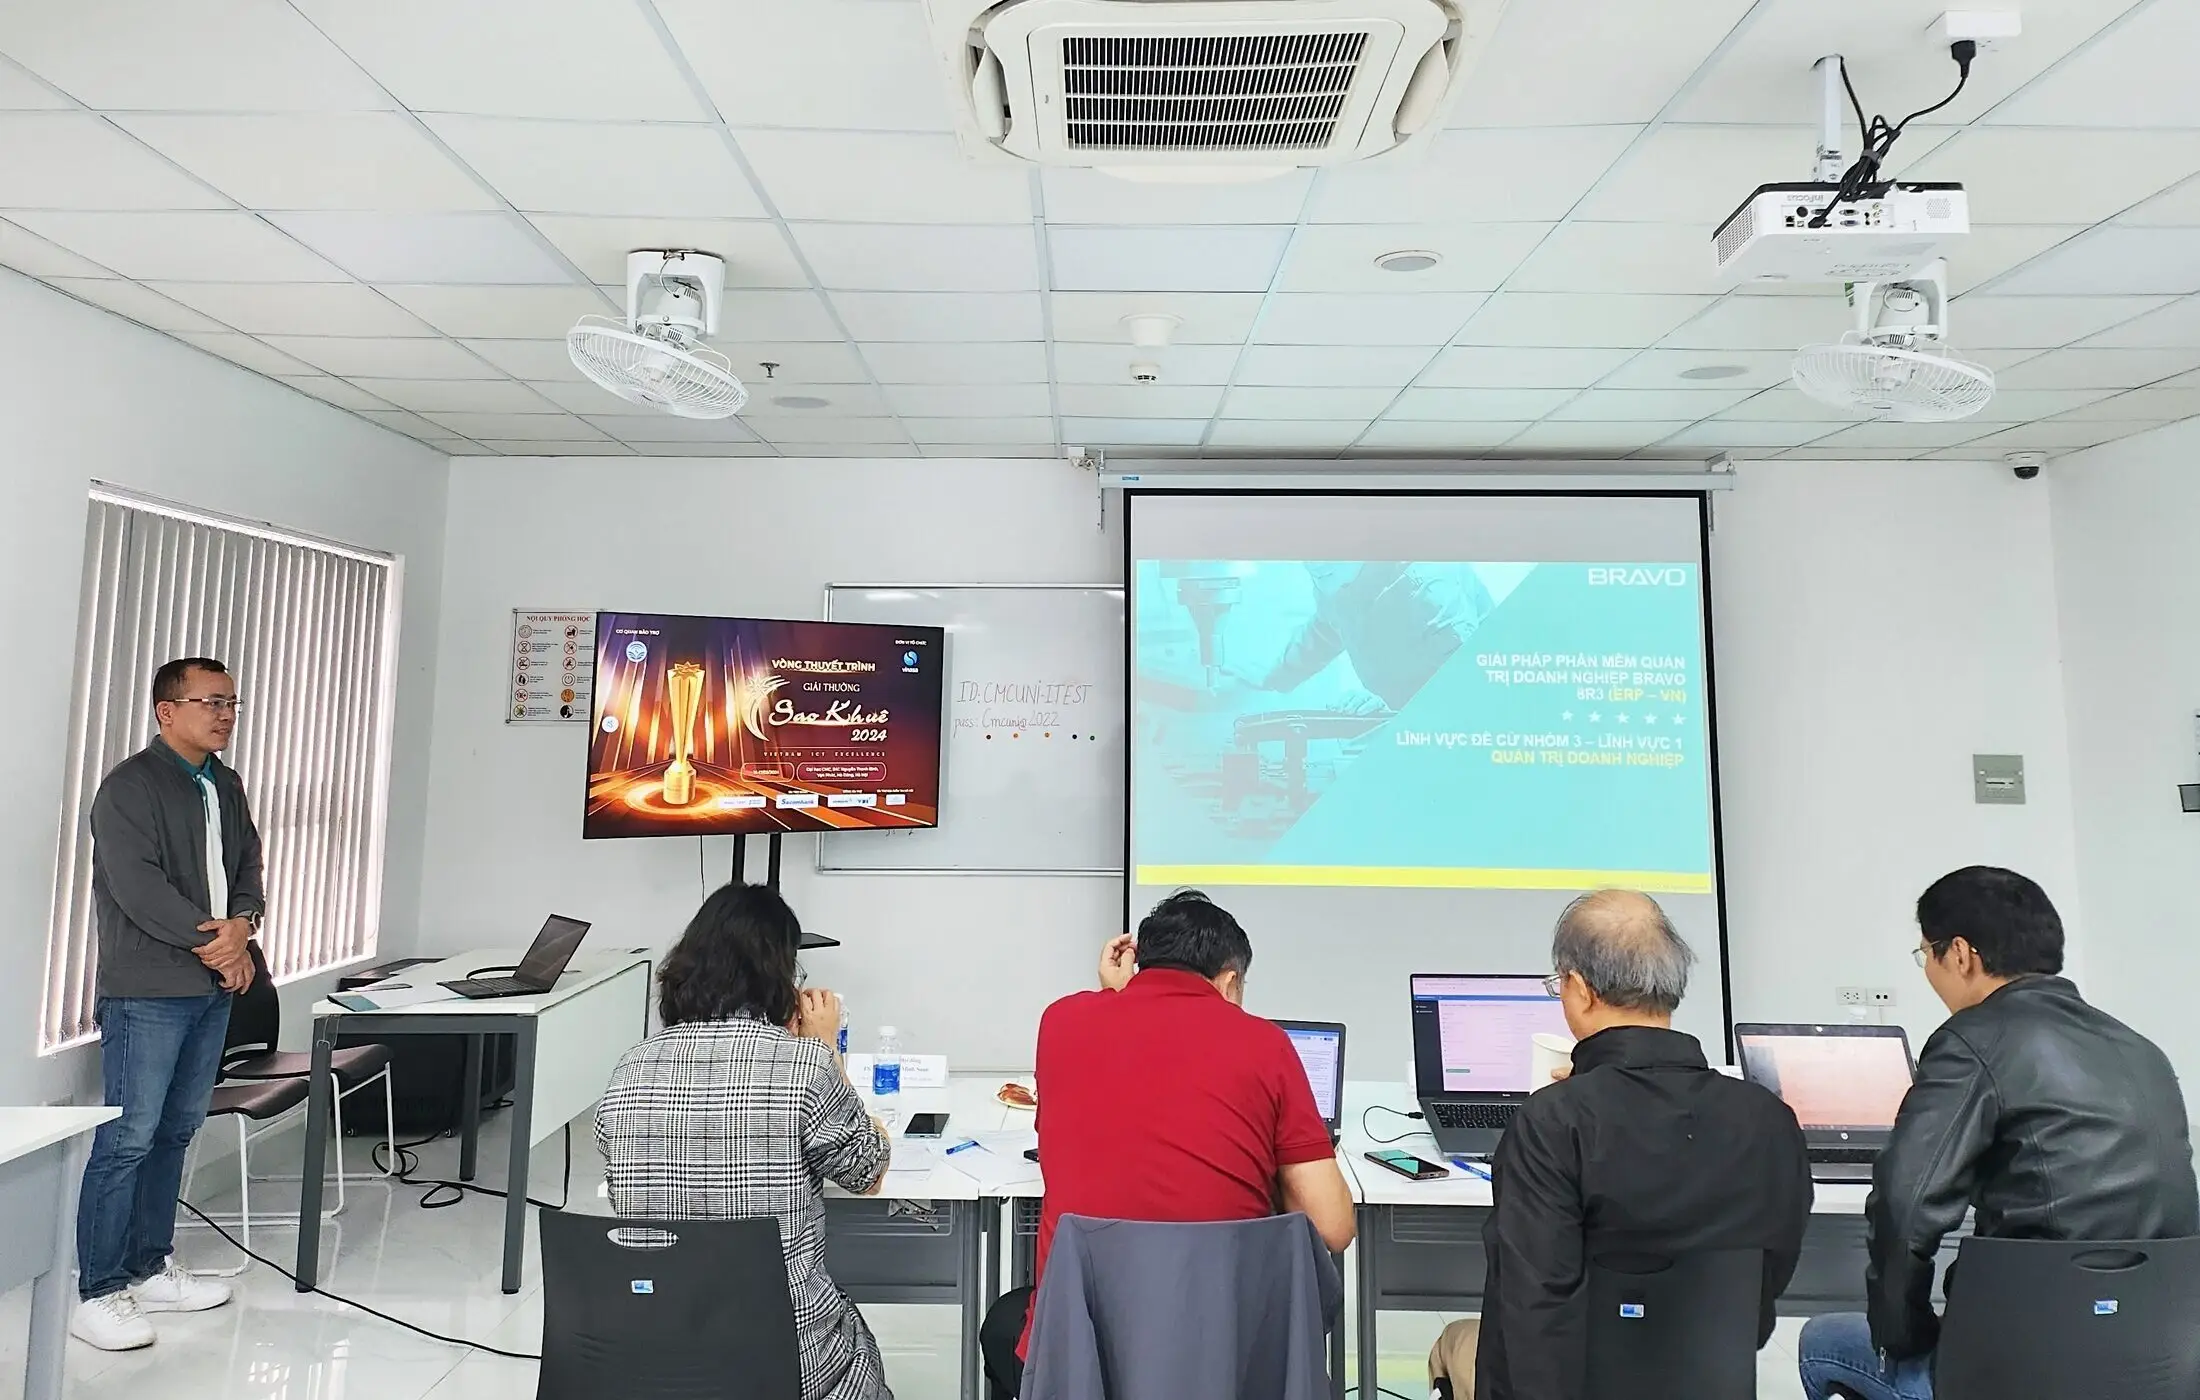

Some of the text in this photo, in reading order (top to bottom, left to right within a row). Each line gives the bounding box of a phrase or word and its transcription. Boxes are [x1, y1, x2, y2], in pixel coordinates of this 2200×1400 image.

[1588, 567, 1686, 586] BRAVO
[772, 658, 876, 671] VÒNG THUYẾT TRÌNH
[1511, 652, 1551, 667] PHÁP
[1485, 670, 1686, 688] TRỊ DOANH NGHIỆP BRAVO
[1608, 688, 1643, 702] (ERP
[1660, 689, 1686, 704] VN)
[768, 699, 889, 726] Sao Khuê
[850, 729, 888, 741] 2024
[1396, 730, 1430, 746] LĨNH
[1435, 732, 1468, 749] VỰC
[1524, 732, 1569, 748] NHÓM
[1573, 735, 1582, 748] 3
[1598, 732, 1633, 748] LĨNH
[1637, 735, 1671, 752] VỰC
[1675, 737, 1683, 749] 1
[1540, 751, 1563, 768] TRỊ
[1567, 751, 1622, 765] DOANH
[1626, 752, 1685, 770] NGHIỆP
